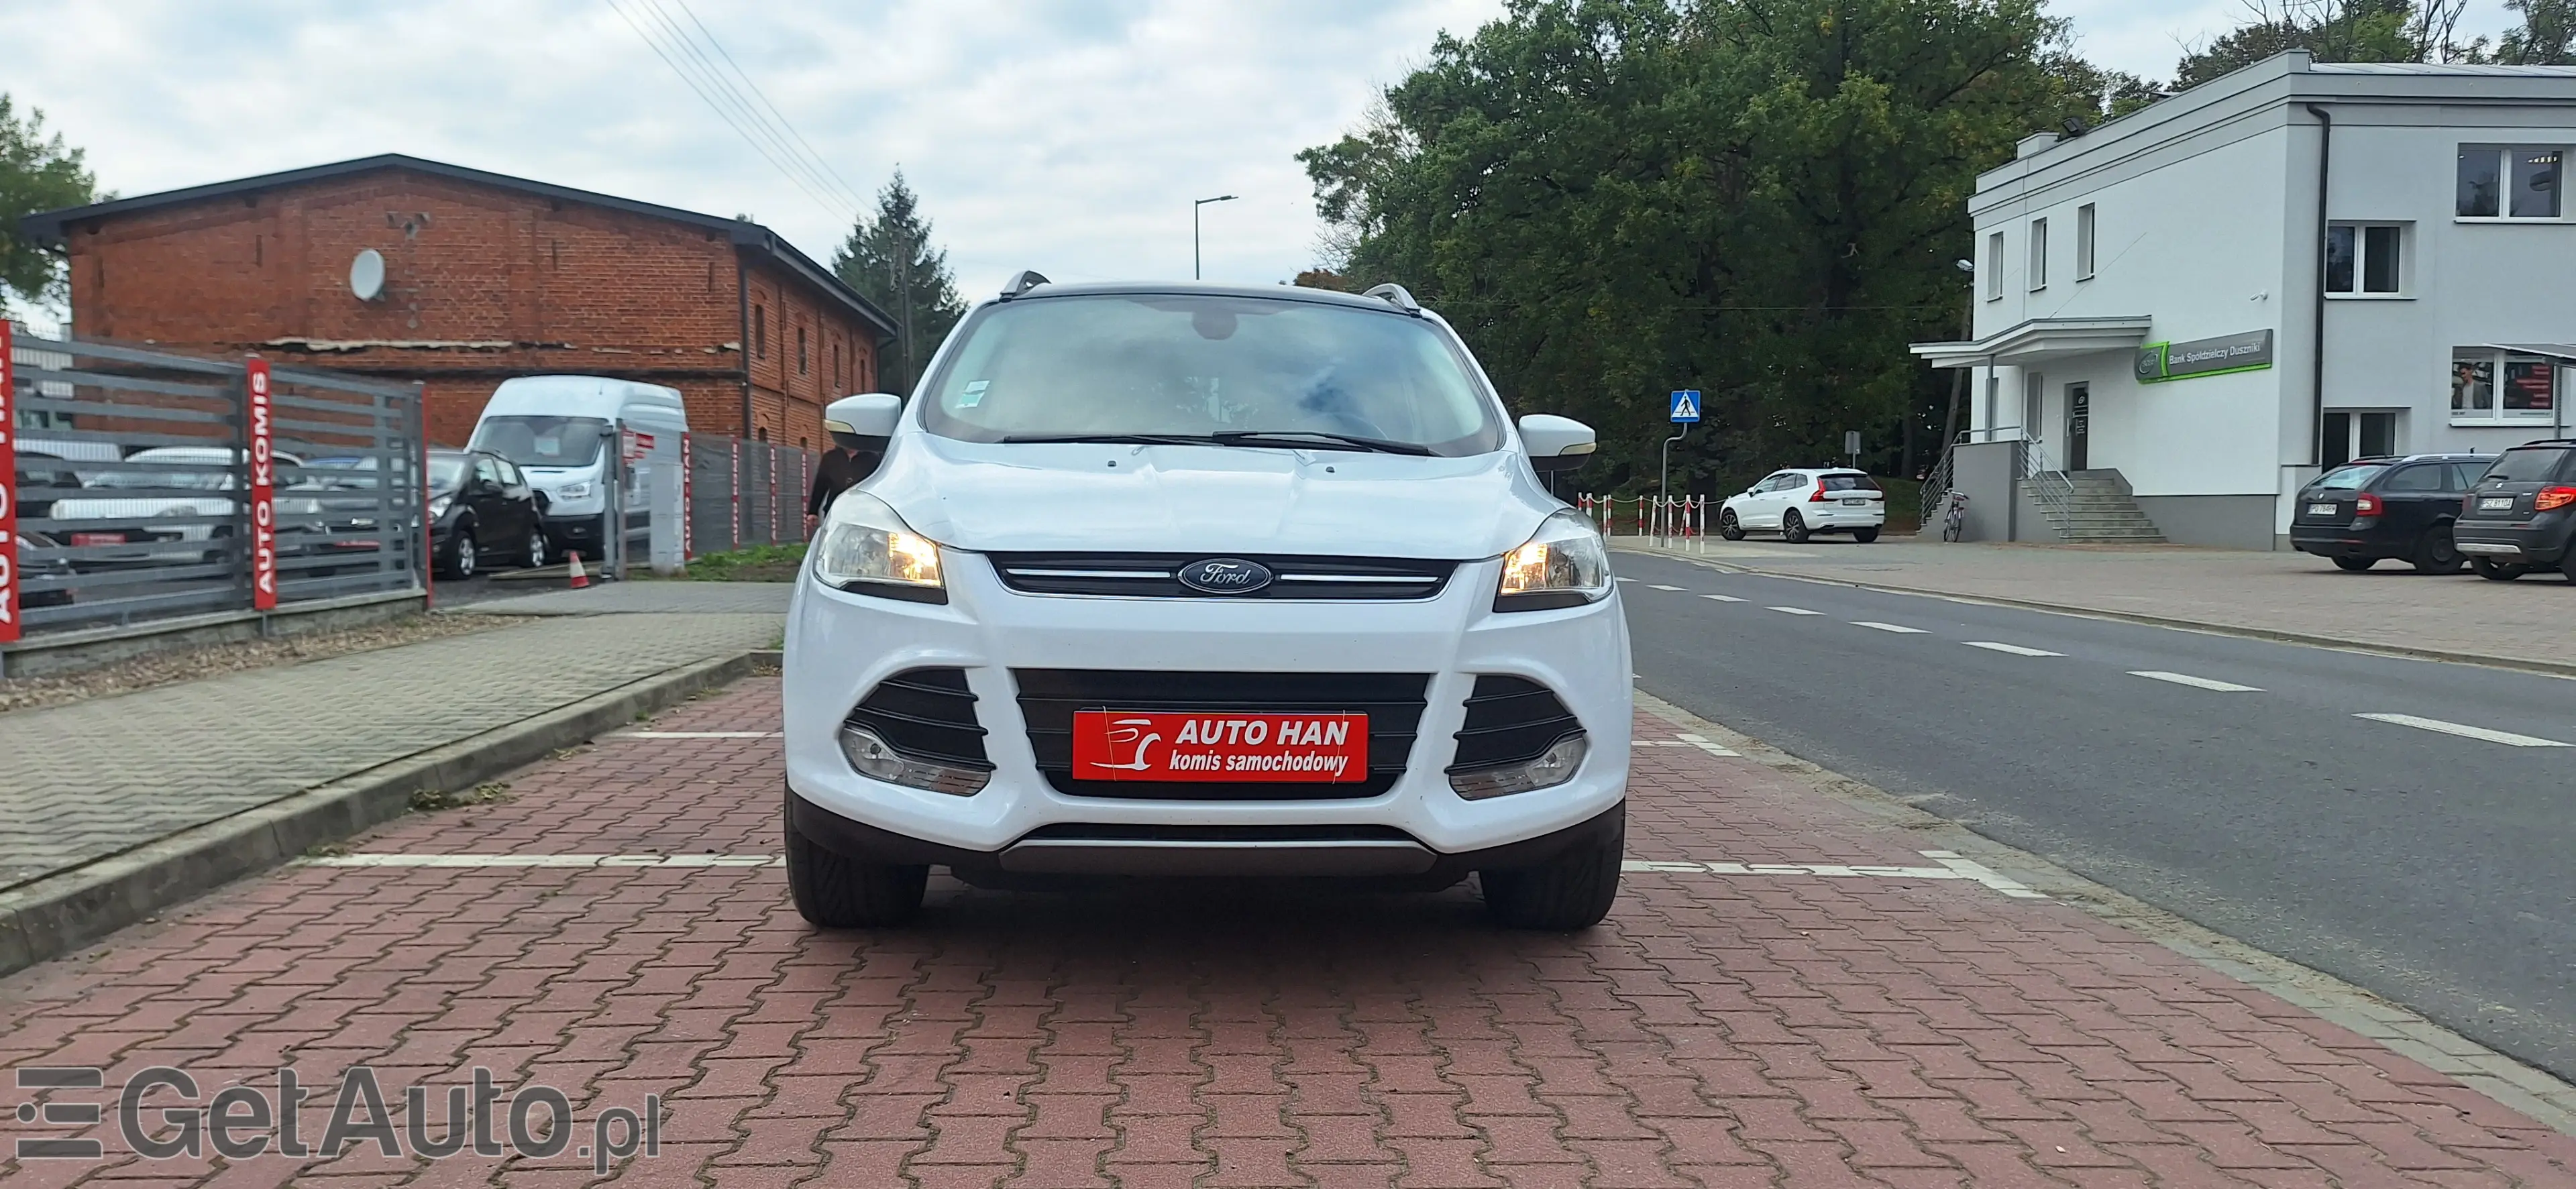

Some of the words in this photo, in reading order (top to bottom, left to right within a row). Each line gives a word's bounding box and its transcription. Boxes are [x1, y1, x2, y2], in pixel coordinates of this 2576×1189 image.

[2169, 353, 2185, 365] Bank
[2186, 347, 2229, 363] Spółdzielczy
[2229, 341, 2261, 356] Duszniki
[253, 372, 269, 486] KOMIS
[257, 500, 274, 594] AUTO
[1199, 563, 1251, 585] Ford
[1175, 720, 1269, 746] AUTO
[1277, 720, 1349, 746] HAN
[1169, 749, 1221, 771] komis
[1225, 750, 1348, 777] samochodowy
